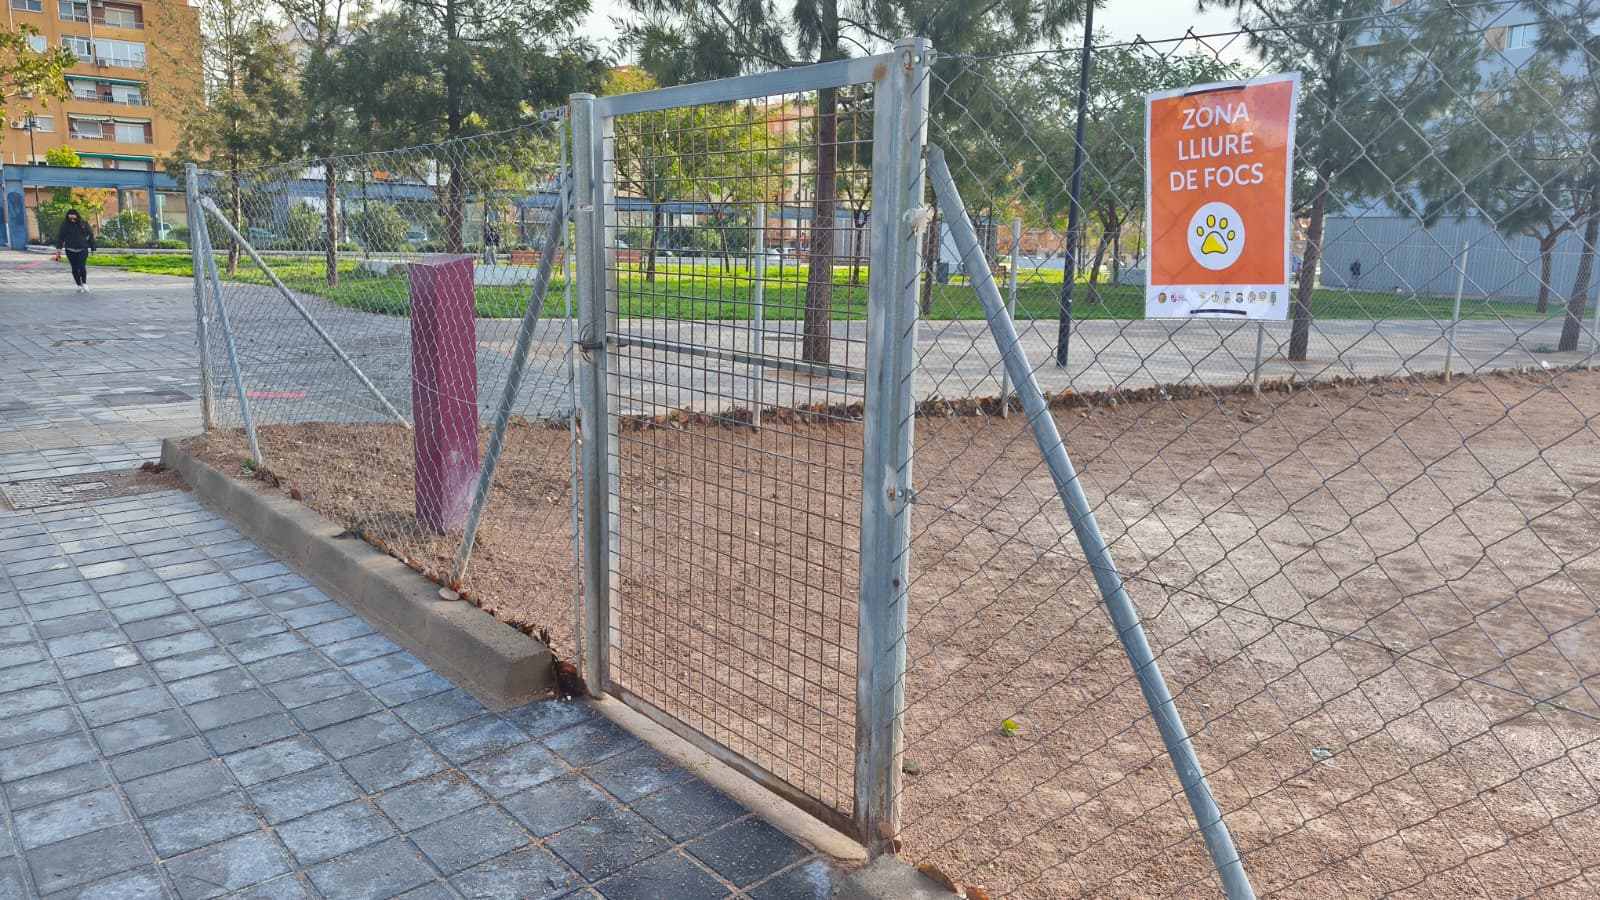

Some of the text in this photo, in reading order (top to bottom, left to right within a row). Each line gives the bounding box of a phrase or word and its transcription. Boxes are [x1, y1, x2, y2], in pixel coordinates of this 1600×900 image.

[1182, 102, 1249, 130] ZONA
[1178, 132, 1254, 161] LLIURE
[1170, 162, 1264, 191] DE FOCS
